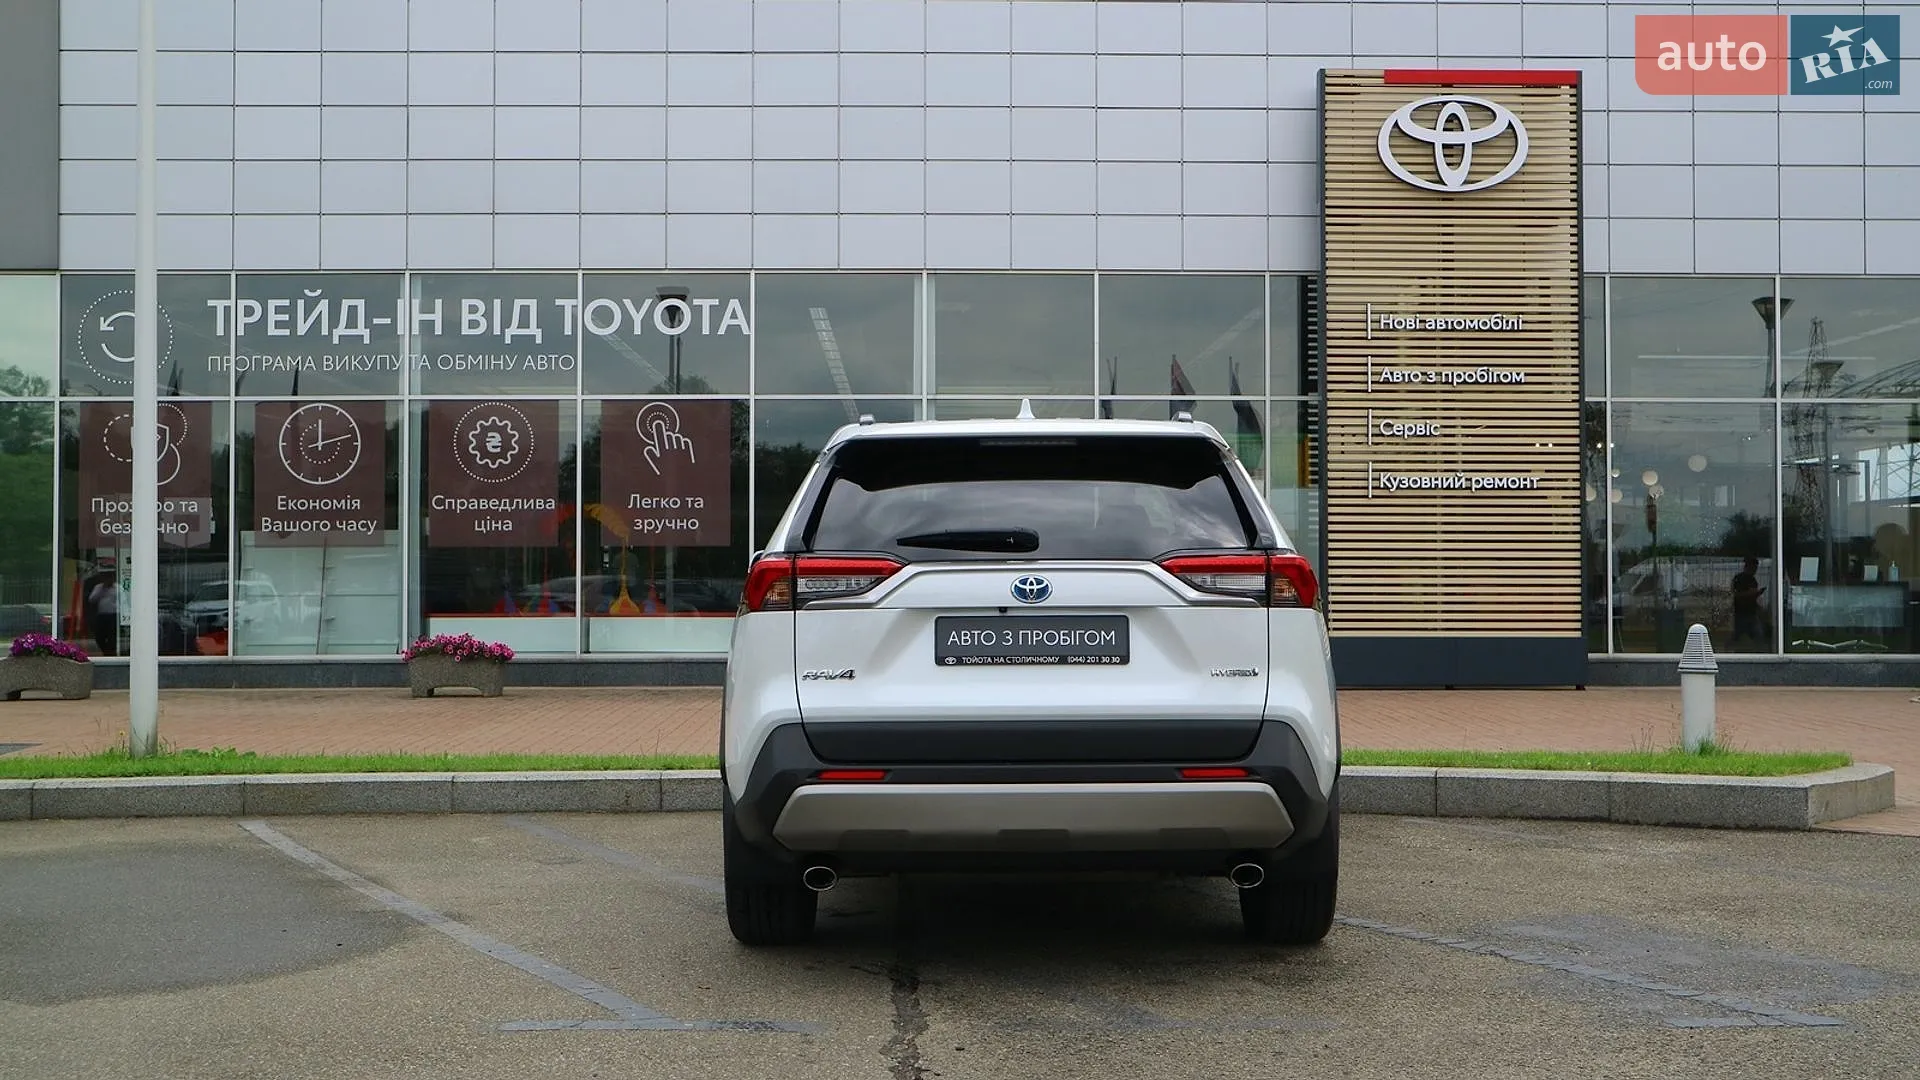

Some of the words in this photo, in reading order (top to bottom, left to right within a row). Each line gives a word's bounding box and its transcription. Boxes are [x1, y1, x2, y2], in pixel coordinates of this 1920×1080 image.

[207, 288, 442, 344] ТРЕЙД-ІН
[461, 298, 543, 344] ВІД
[555, 298, 753, 336] TOYOTA
[1379, 314, 1420, 331] Нові
[1425, 314, 1523, 331] автомобілі
[207, 354, 317, 372] ПРОГРАМА
[323, 354, 404, 371] ВИКУПУ
[407, 354, 431, 371] ТА
[437, 354, 518, 371] ОБМІНУ
[522, 354, 576, 371] АВТО
[1379, 367, 1422, 384] Авто
[1427, 371, 1436, 384] з
[1441, 367, 1526, 387] пробігом
[1379, 420, 1440, 439] Сервіс
[1379, 472, 1467, 492] Кузовний
[1472, 476, 1541, 492] ремонт
[91, 497, 175, 517] Проо
[179, 500, 198, 513] та
[277, 495, 361, 511] Економія
[431, 495, 556, 512] Справедлива
[628, 494, 681, 510] Легко
[685, 497, 704, 509] та
[100, 518, 190, 534] безчно
[261, 517, 329, 532] Вашого
[336, 520, 377, 536] часу
[474, 517, 514, 533] ціна
[633, 517, 700, 532] зручно
[947, 629, 997, 646] АВТО
[1002, 630, 1014, 646] З
[1018, 629, 1116, 646] ПРОБІГОМ
[961, 655, 993, 665] ТОЙОТА
[994, 656, 1005, 664] НА
[1006, 656, 1060, 665] СТОЛИЧНОМУ
[1087, 656, 1099, 664] 201
[1100, 656, 1110, 664] 30
[1111, 656, 1121, 664] 30
[801, 668, 857, 681] RAV4
